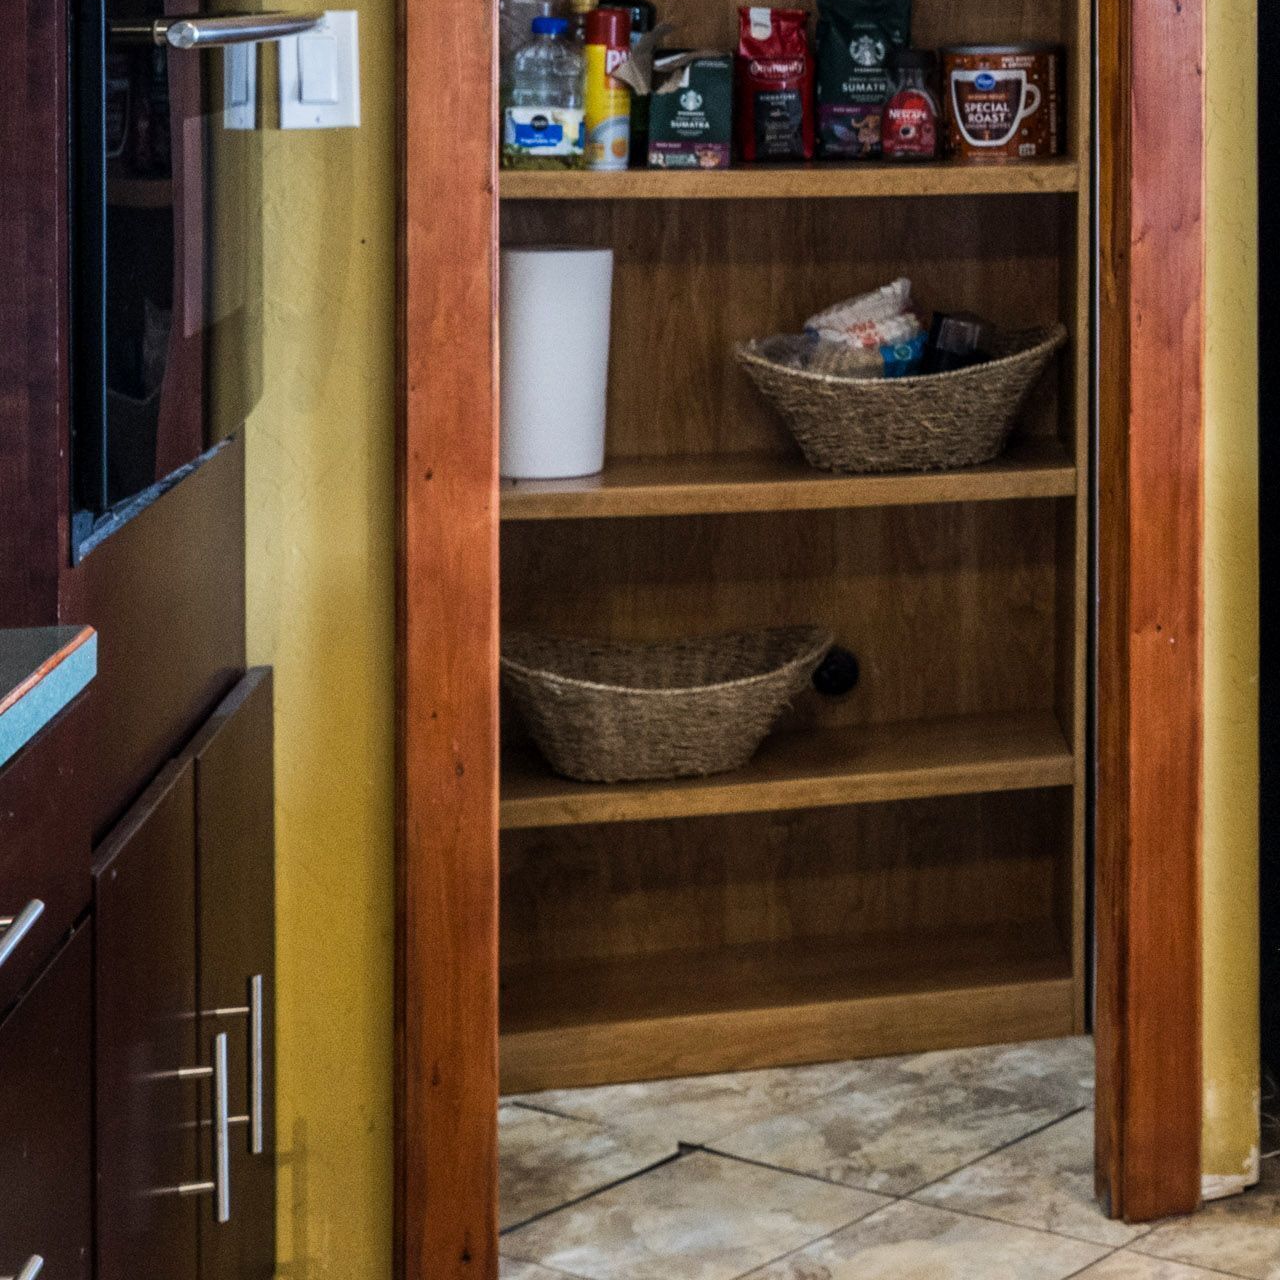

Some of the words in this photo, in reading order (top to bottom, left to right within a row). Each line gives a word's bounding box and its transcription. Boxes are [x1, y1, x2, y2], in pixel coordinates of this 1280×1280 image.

[841, 82, 887, 93] SUMATR
[964, 102, 1009, 112] SPECIAL
[968, 113, 1005, 122] ROAST
[670, 121, 710, 129] SUMATRA
